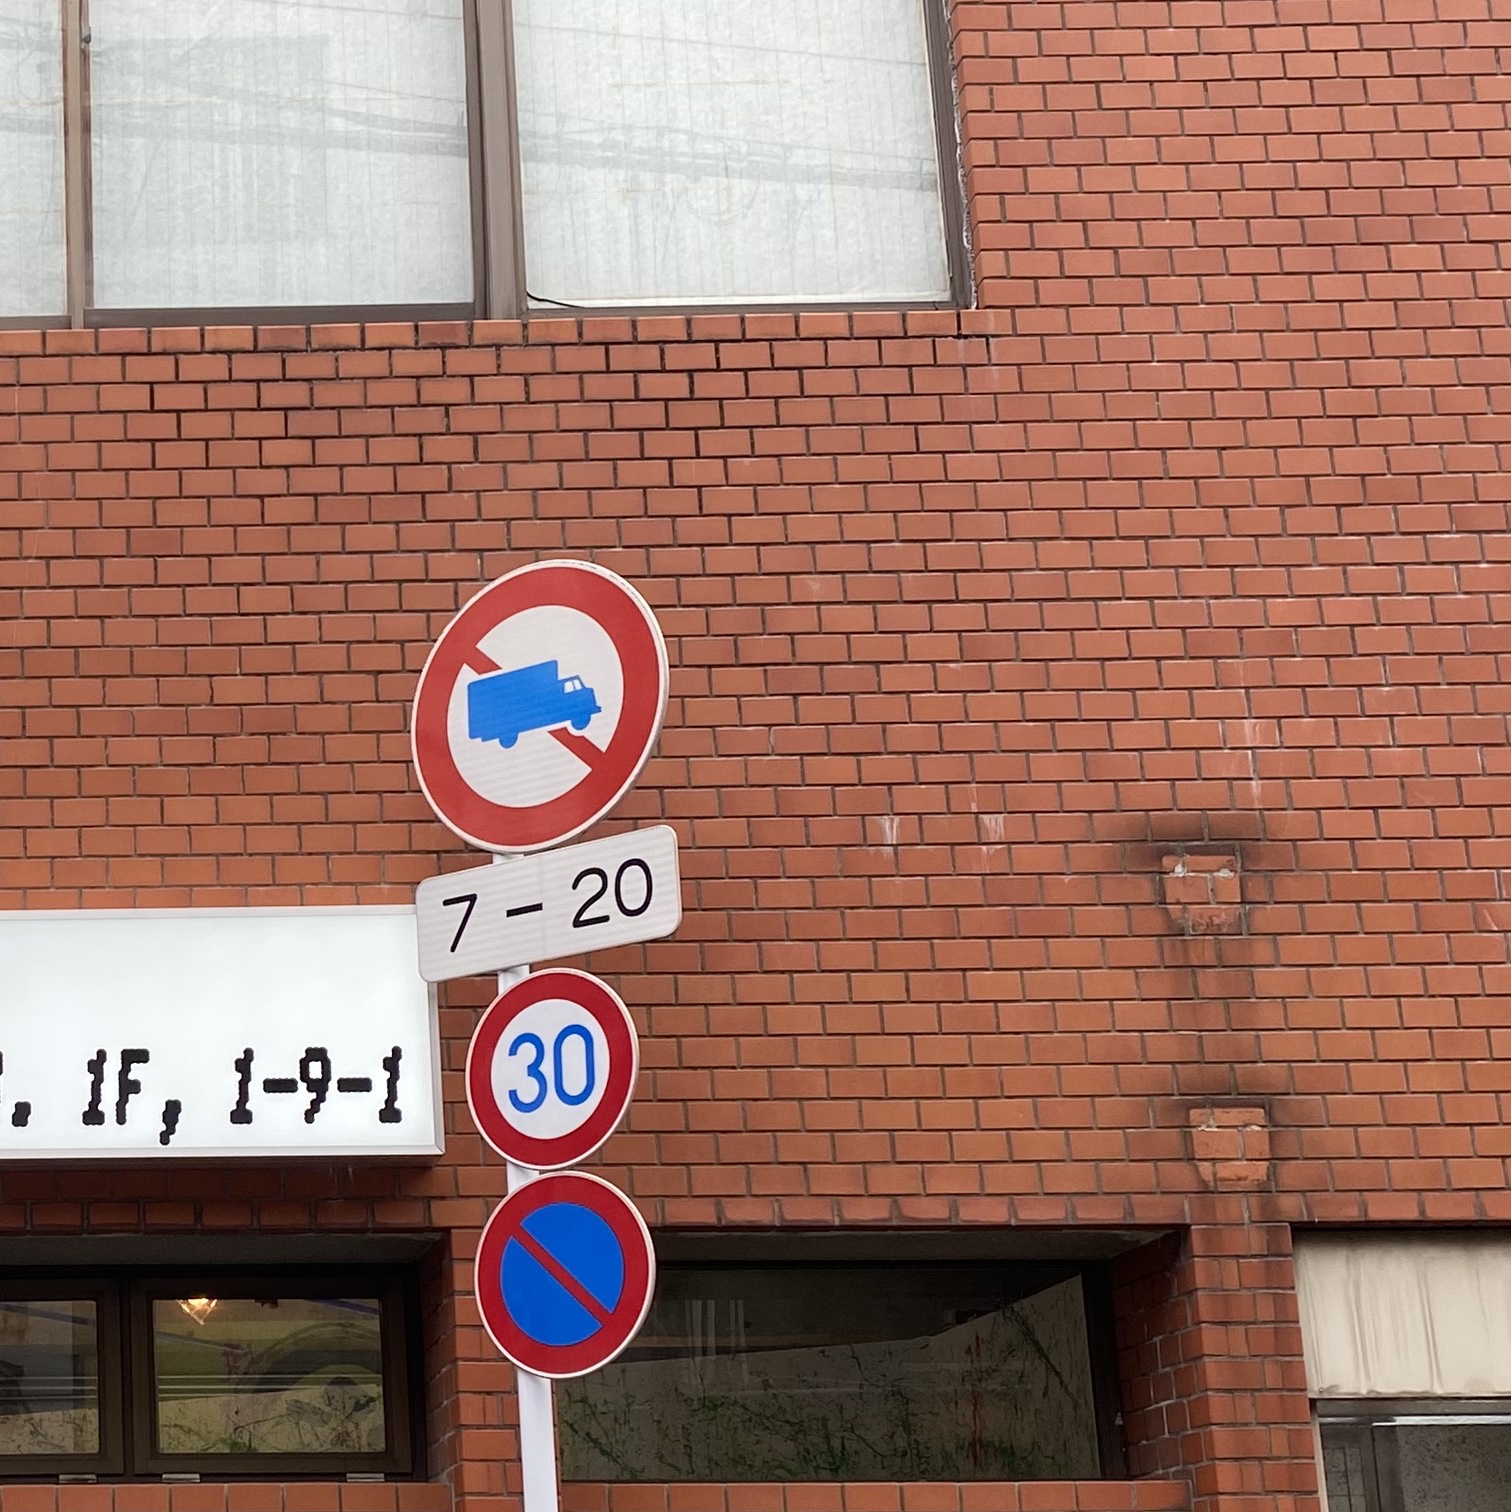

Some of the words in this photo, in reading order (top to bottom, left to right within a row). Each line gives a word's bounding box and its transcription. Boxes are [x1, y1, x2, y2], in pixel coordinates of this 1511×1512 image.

[443, 894, 478, 952] 7
[572, 859, 653, 929] 20
[83, 1049, 181, 1145] 1F,
[230, 1046, 401, 1124] 1-9-1
[507, 1023, 596, 1114] 30
